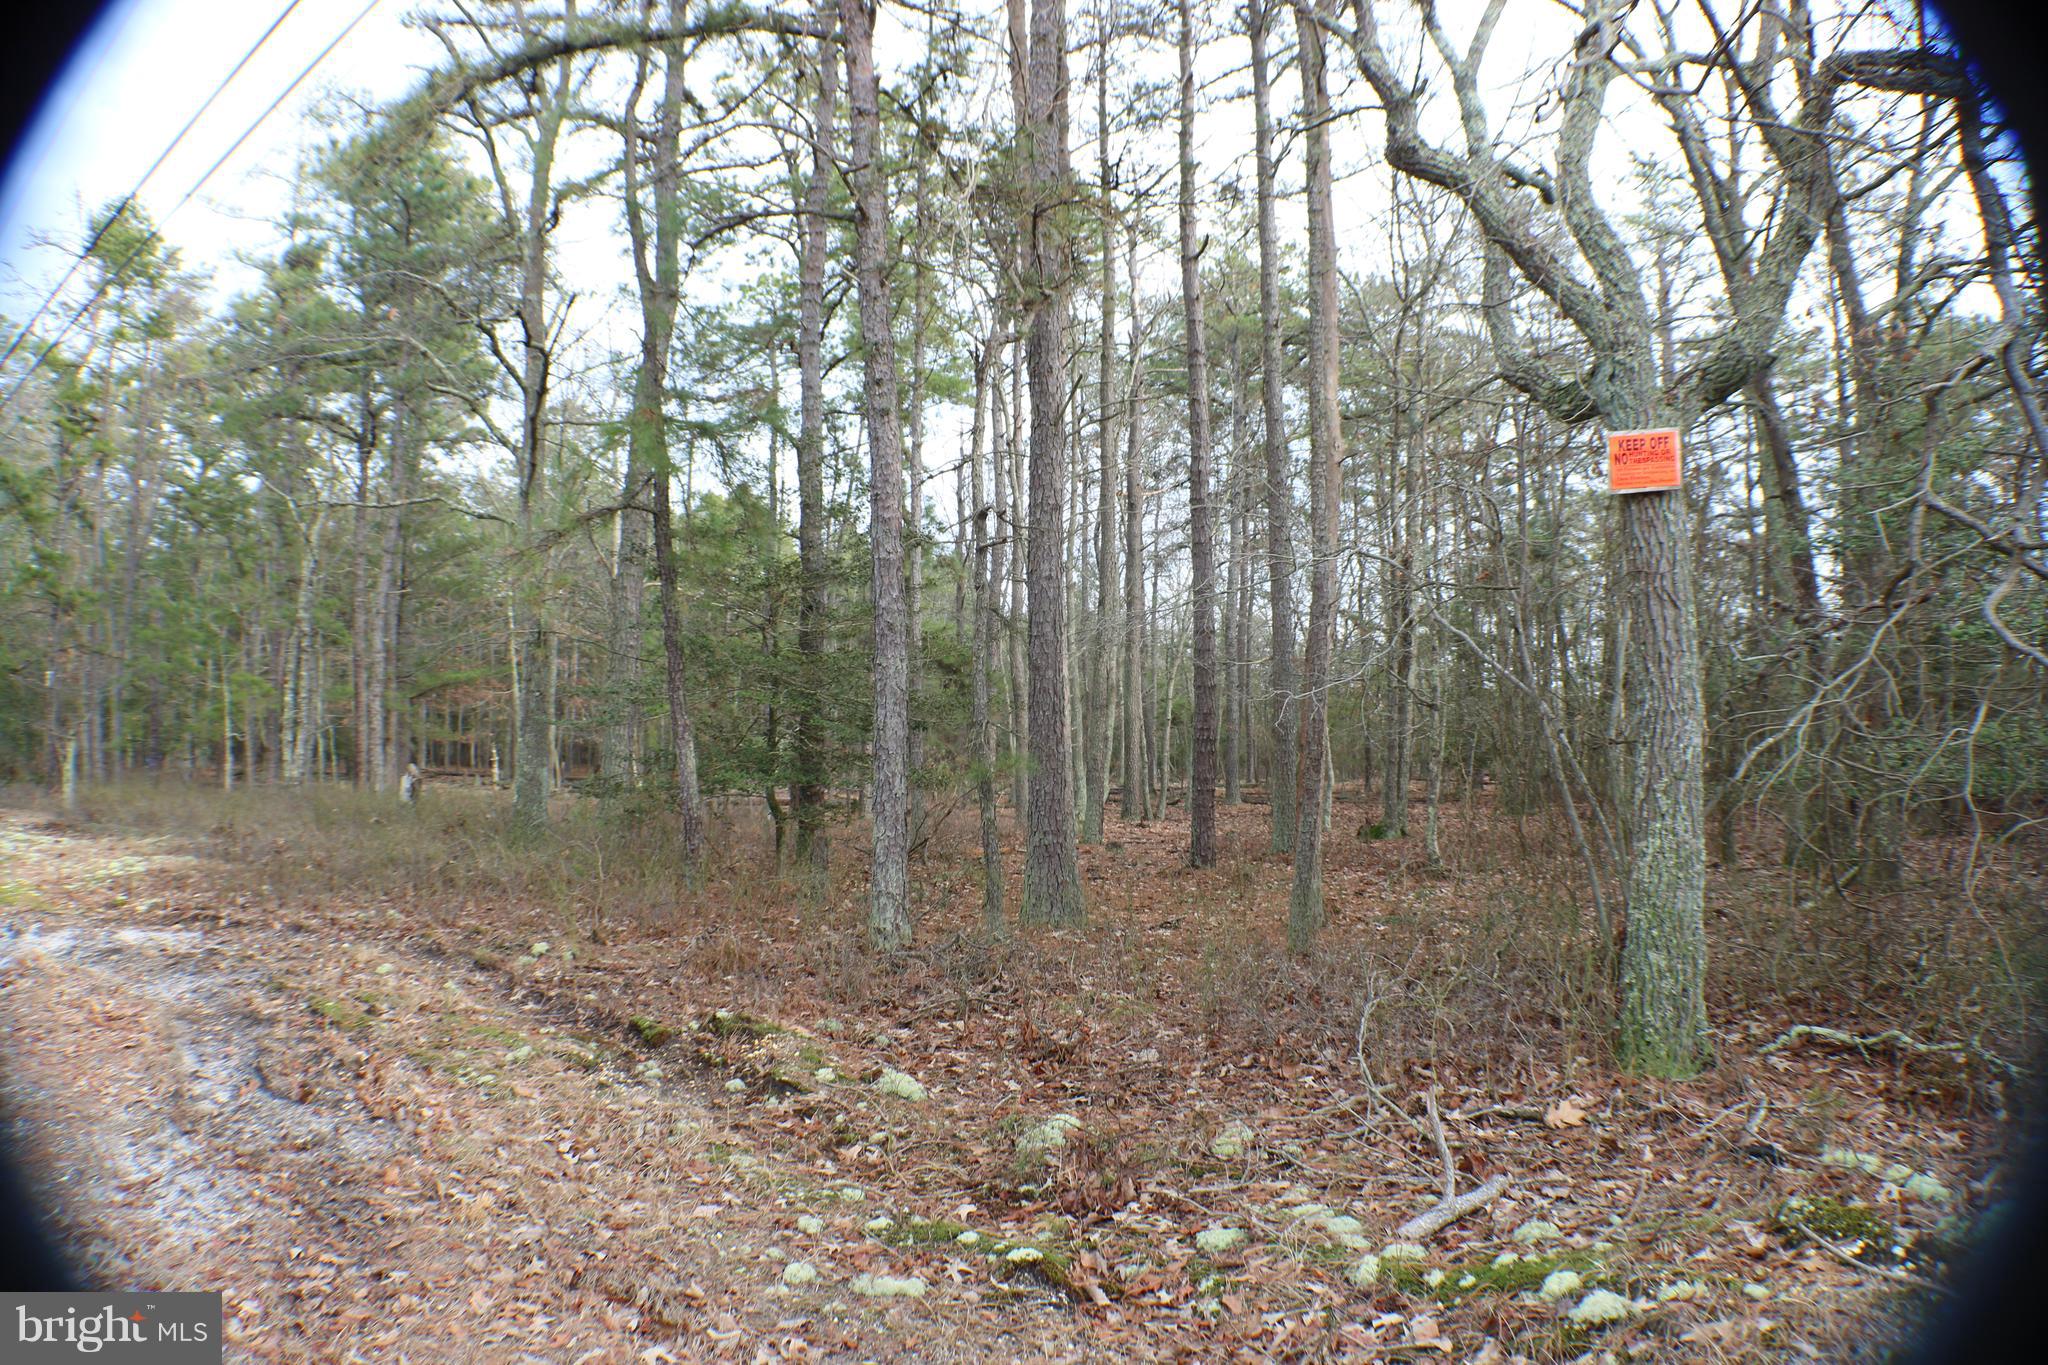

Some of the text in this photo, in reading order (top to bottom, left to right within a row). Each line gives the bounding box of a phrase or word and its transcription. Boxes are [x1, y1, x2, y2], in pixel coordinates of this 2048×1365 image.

[1618, 436, 1669, 452] KEEP OFF
[1614, 453, 1628, 465] NO
